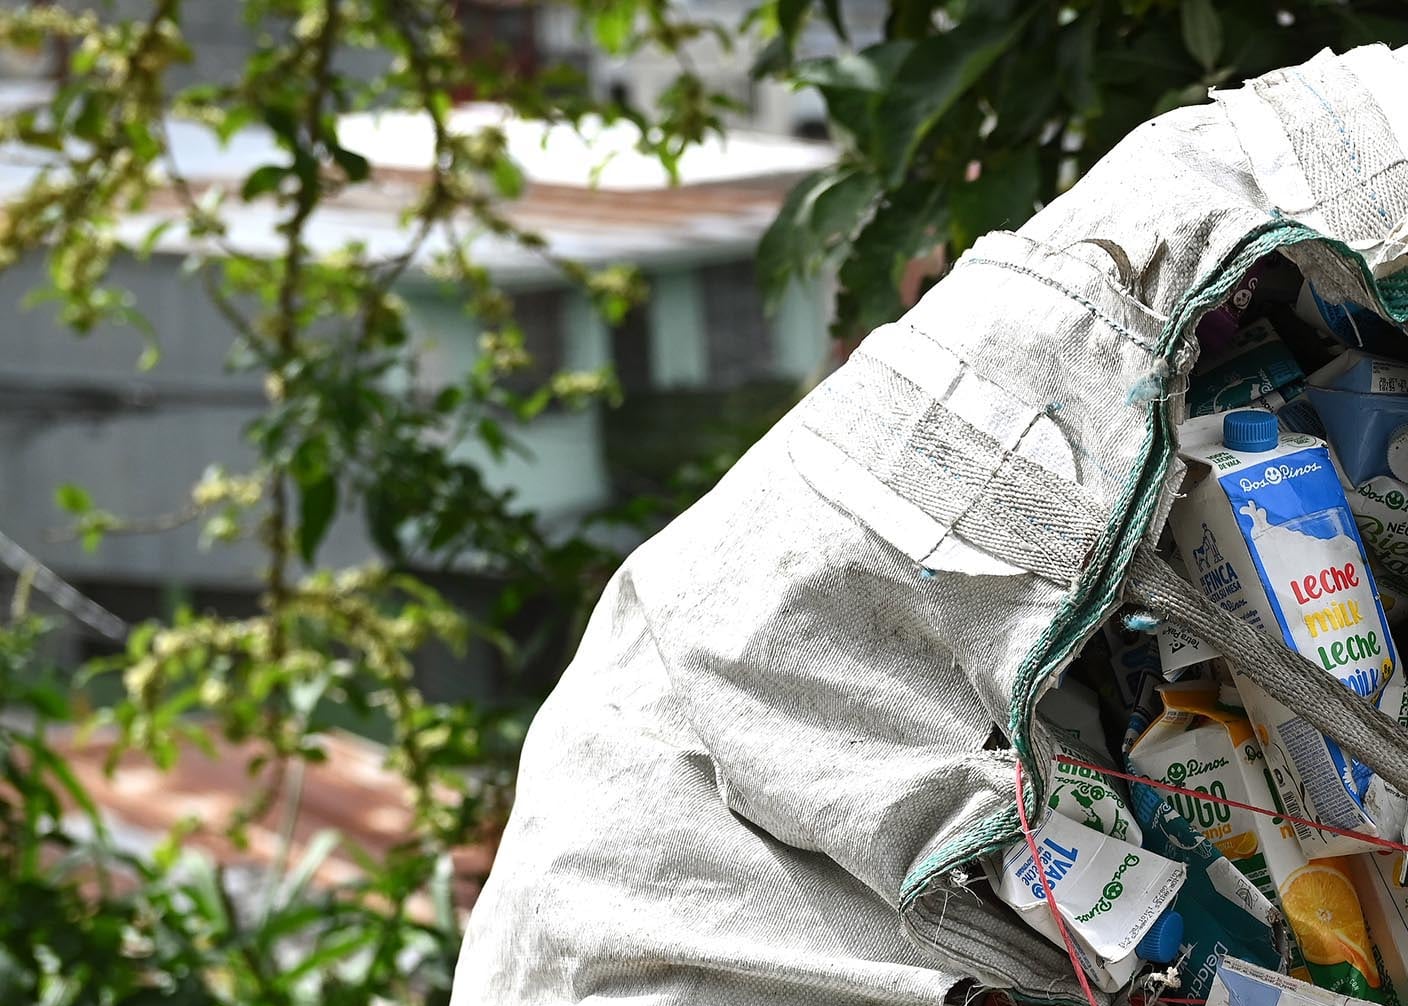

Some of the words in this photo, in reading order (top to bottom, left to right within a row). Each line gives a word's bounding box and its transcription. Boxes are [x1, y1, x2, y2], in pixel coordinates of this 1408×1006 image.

[1240, 477, 1267, 492] Dos
[1280, 462, 1322, 480] Pinos
[1358, 484, 1385, 504] Dos
[1205, 565, 1238, 593] FINCA
[1290, 562, 1360, 606] Leche
[1304, 599, 1365, 639] milk
[1317, 631, 1381, 671] Leche
[1187, 756, 1229, 778] Pinos
[1054, 777, 1091, 795] Pinos
[1105, 791, 1127, 809] Dos
[1112, 853, 1140, 882] Dos
[1074, 899, 1112, 924] Pinos
